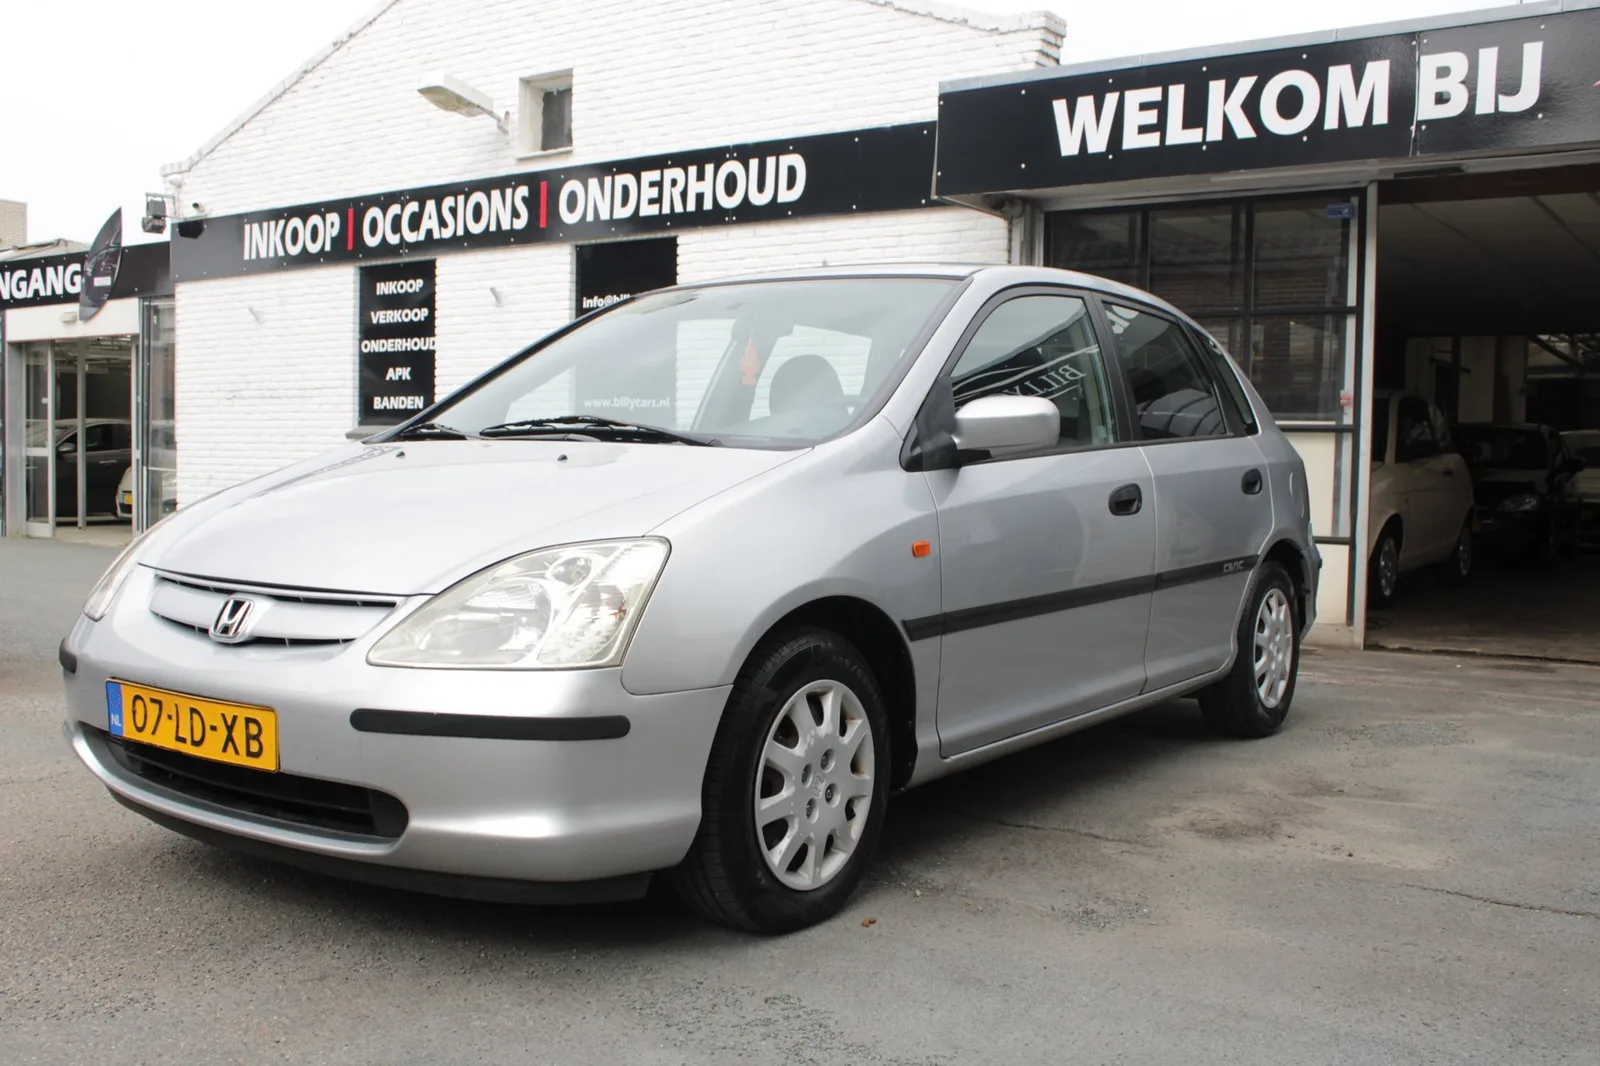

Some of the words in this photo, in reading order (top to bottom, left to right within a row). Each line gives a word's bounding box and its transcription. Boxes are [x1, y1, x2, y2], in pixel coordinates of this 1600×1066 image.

[1051, 59, 1391, 158] WELKOM
[1416, 40, 1544, 121] BIJ
[243, 212, 340, 260] INKOOP
[362, 185, 529, 247] OCCASIONS
[558, 153, 807, 225] ONDERHOUD
[376, 278, 424, 295] INKOOP
[370, 307, 429, 324] VERKOOP
[361, 336, 436, 353] ONDERHOUD
[385, 366, 411, 381] APK
[373, 395, 424, 410] BANDEN
[583, 396, 670, 411] www.billycars.nl
[111, 712, 122, 727] NL
[131, 694, 264, 759] 07-LD-XB
